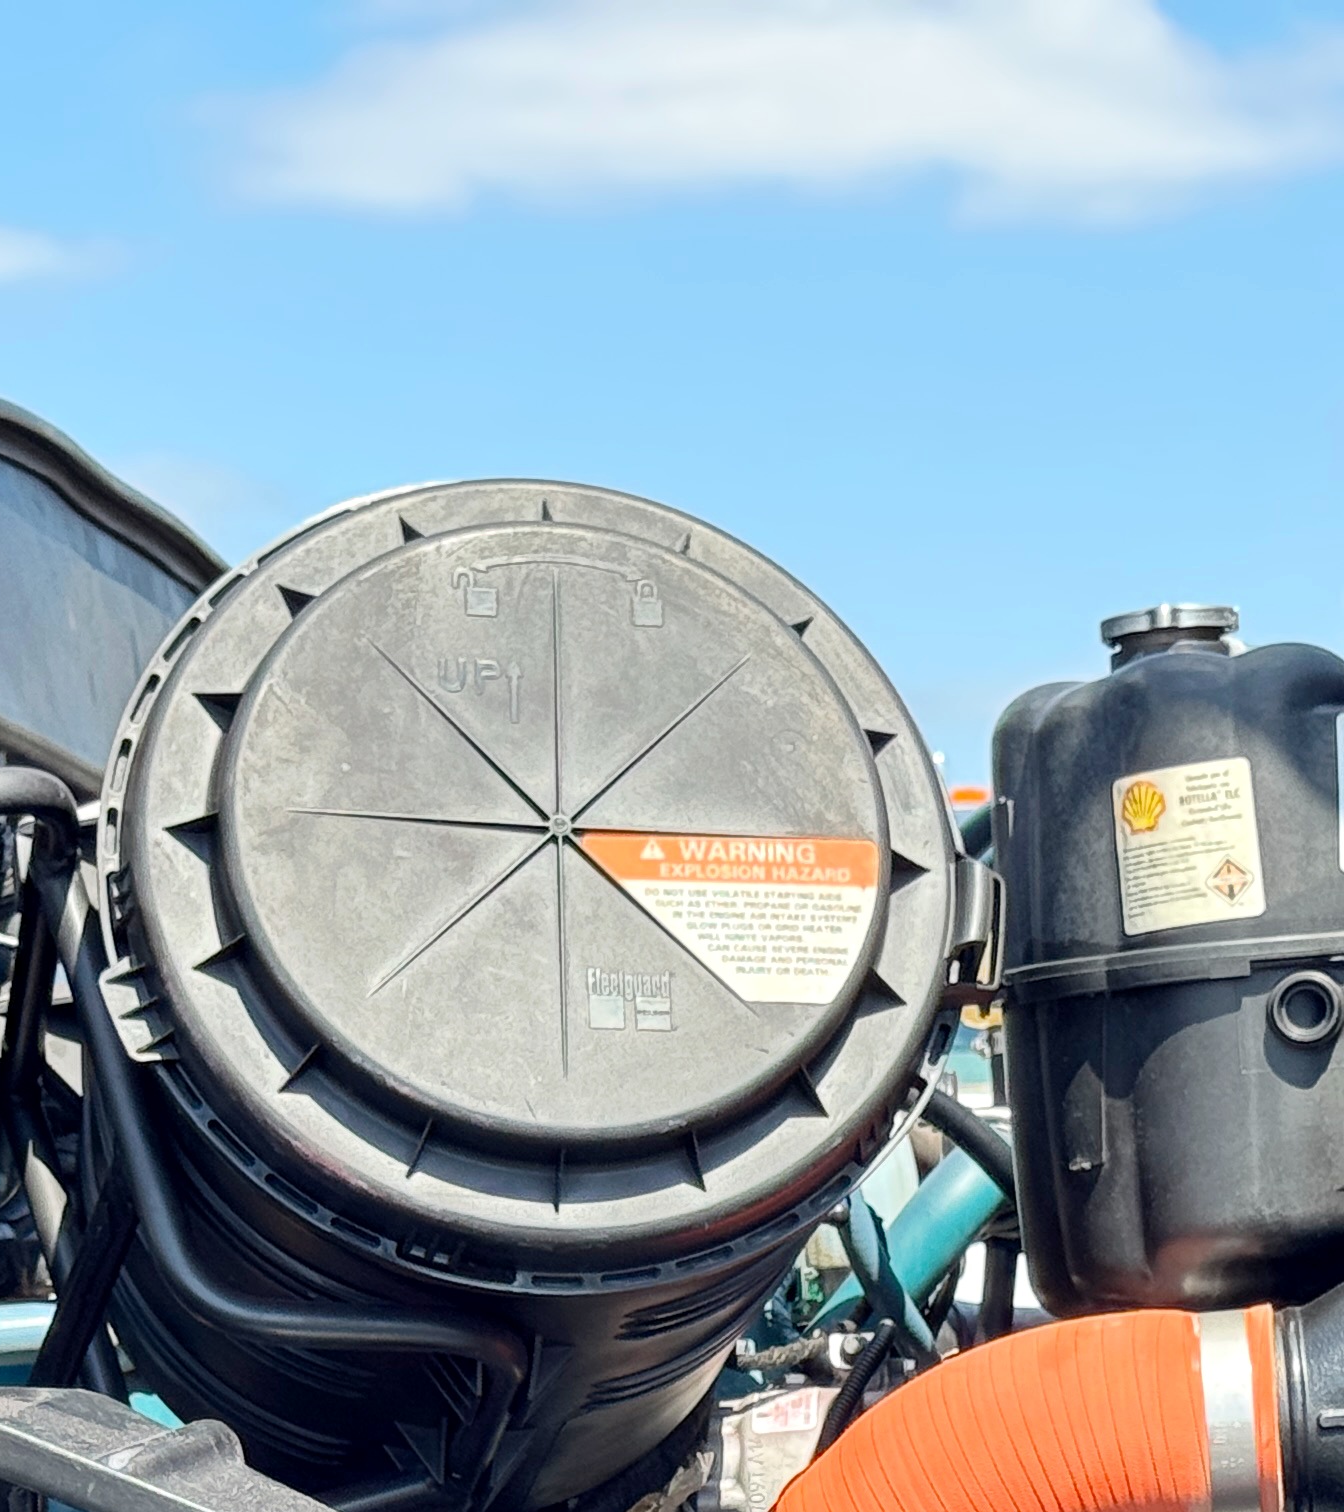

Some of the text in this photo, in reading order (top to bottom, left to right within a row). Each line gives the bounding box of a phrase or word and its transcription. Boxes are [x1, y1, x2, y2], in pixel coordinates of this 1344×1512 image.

[678, 840, 816, 865] WARNING
[659, 863, 851, 883] EXPLOSION HAZARD
[586, 966, 672, 1002] Fleetguard
